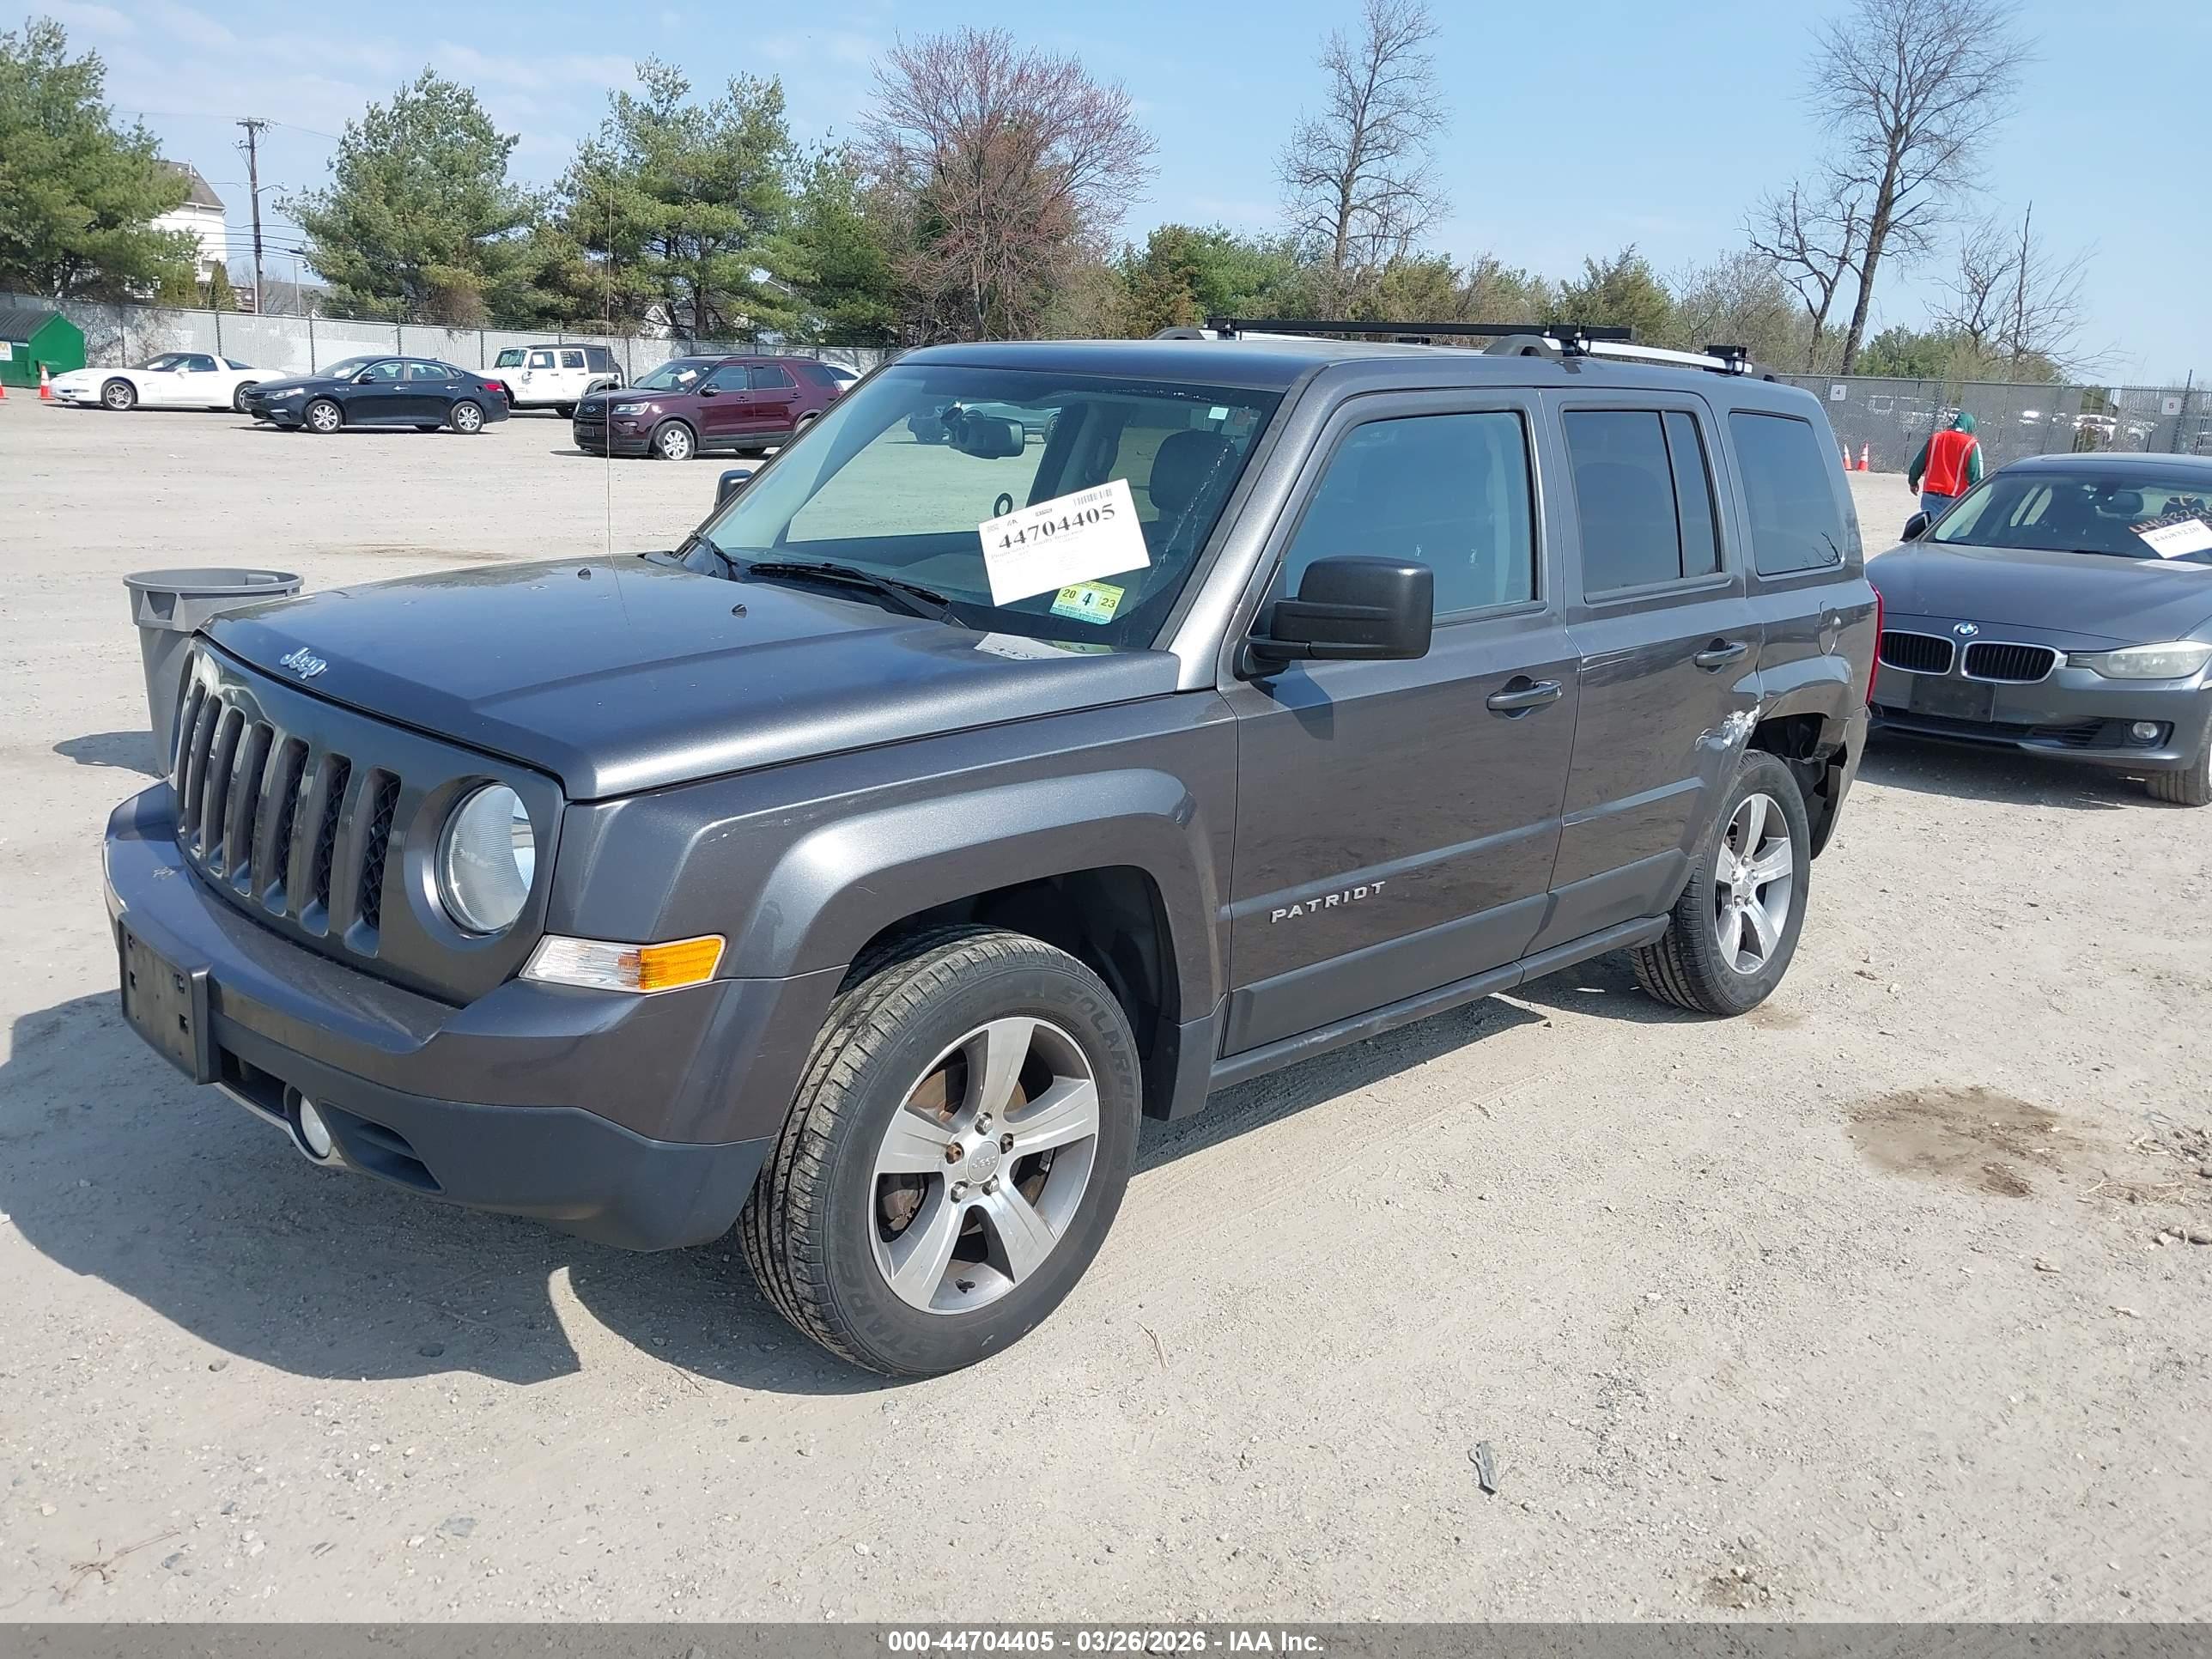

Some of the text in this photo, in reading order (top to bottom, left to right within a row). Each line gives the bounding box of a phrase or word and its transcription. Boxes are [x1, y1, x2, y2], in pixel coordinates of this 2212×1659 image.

[999, 503, 1115, 549] 44704405
[1062, 589, 1077, 599] 20
[1082, 592, 1093, 606] 4
[1101, 598, 1115, 608] 23
[280, 647, 328, 680] Jeep
[1270, 880, 1386, 924] PATRIOT
